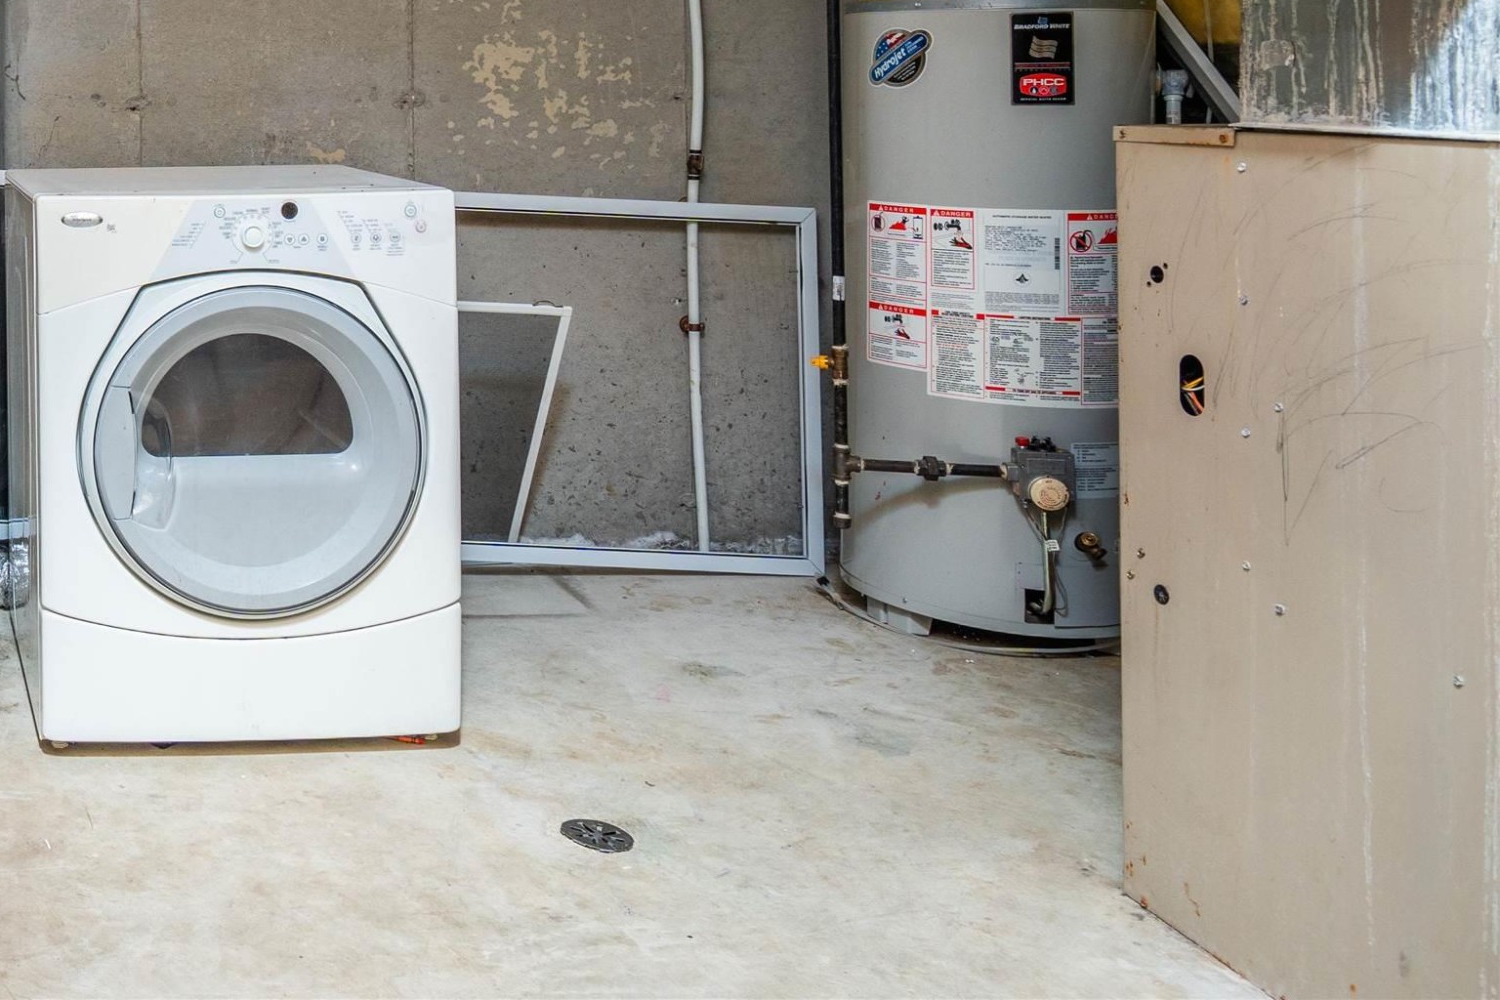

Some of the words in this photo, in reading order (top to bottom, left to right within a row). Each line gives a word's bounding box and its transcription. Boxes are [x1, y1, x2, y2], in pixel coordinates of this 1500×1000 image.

[874, 47, 907, 79] Hydrojet
[1023, 78, 1065, 86] PHCC
[883, 205, 914, 213] DANGER
[883, 305, 914, 314] DANGER
